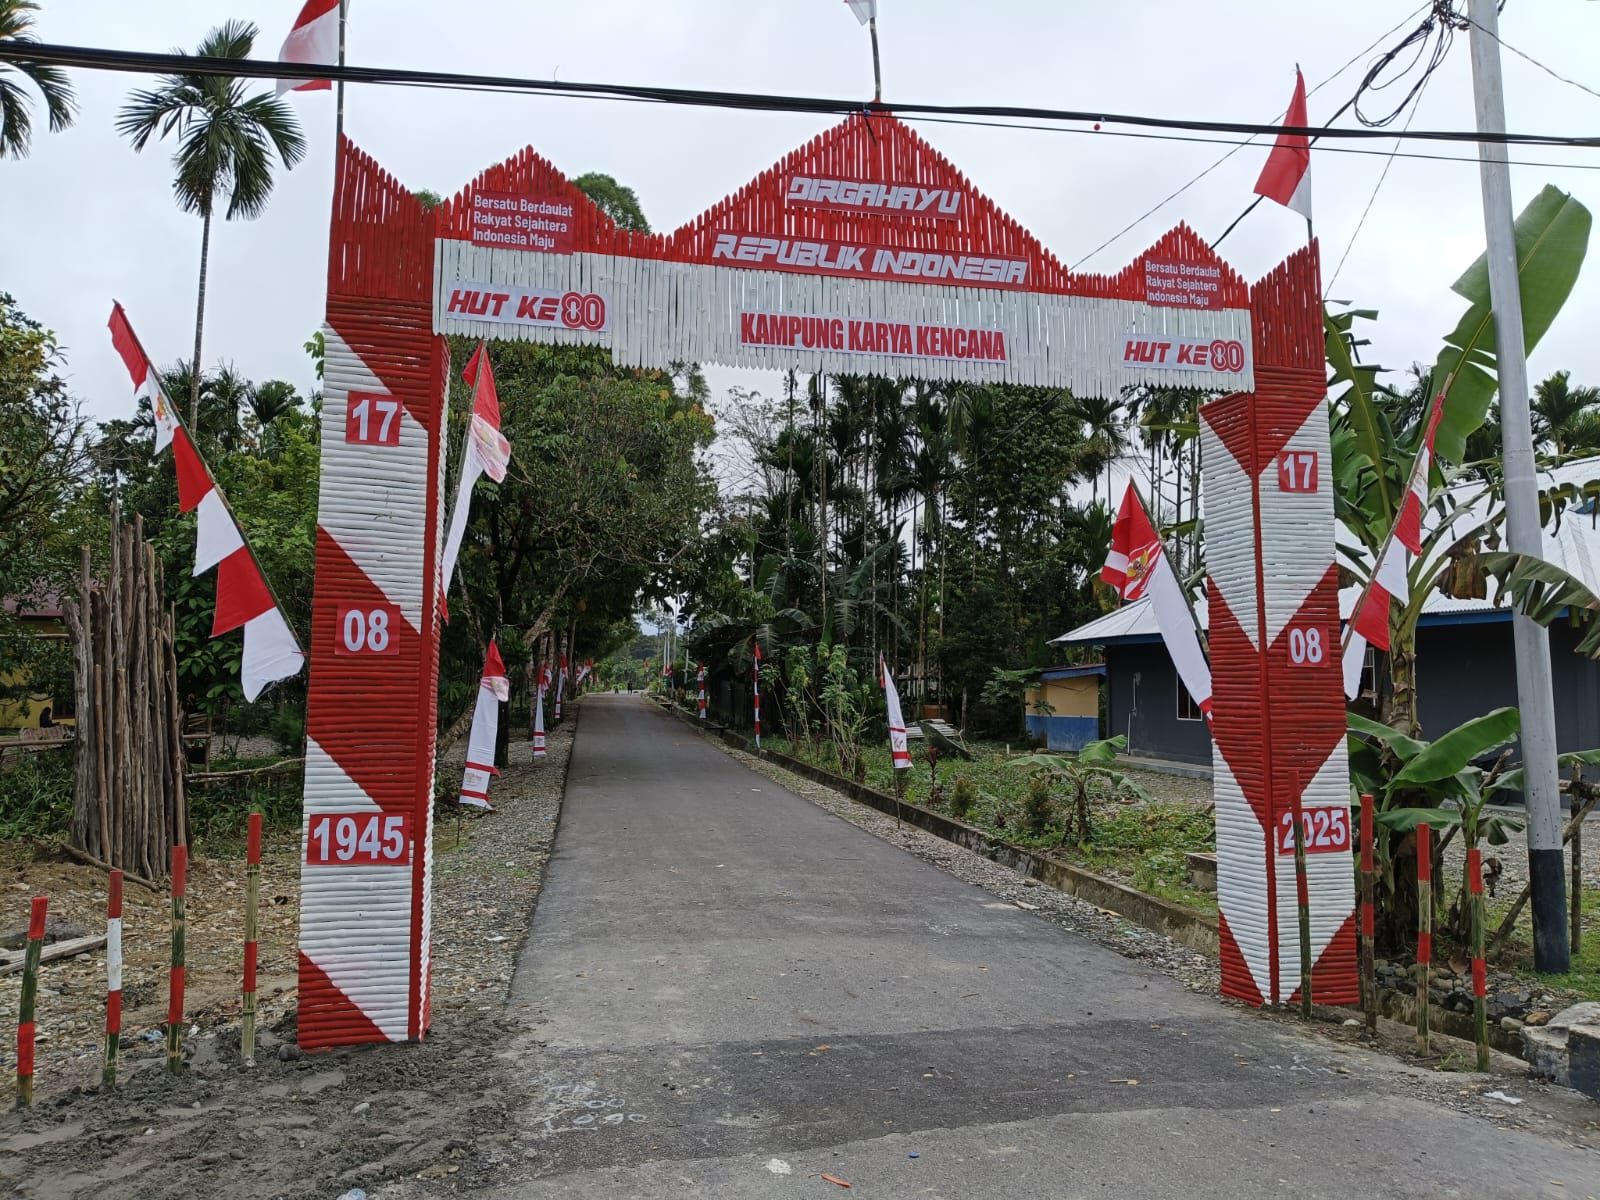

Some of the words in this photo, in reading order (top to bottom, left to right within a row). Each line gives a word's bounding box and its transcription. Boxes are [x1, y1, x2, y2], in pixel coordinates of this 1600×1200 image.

[474, 195, 518, 211] Bersatu
[520, 199, 573, 217] Berdaulat
[788, 176, 961, 214] DIRGAHAYU
[473, 212, 512, 228] Rakyat
[514, 217, 567, 234] Sejahtera
[473, 227, 527, 245] Indonesia
[529, 233, 555, 249] Maju
[712, 233, 866, 271] REPUBLIK
[871, 249, 1028, 284] INDONESIA
[1145, 260, 1178, 273] Bersatu
[1180, 264, 1221, 278] Berdaulat
[1146, 275, 1175, 290] Rakyat
[1177, 278, 1217, 293] Sejahtera
[1146, 290, 1188, 304] Indonesia
[1189, 293, 1209, 307] Maju
[447, 289, 509, 316] HUT
[741, 312, 844, 350] KAMPUNG
[848, 320, 913, 355] KARYA
[916, 326, 1006, 360] KENCANA
[1124, 340, 1171, 363] HUT
[352, 399, 398, 442] 17
[1283, 453, 1314, 489] 17
[343, 609, 389, 651] 08
[1289, 627, 1322, 664] 08
[313, 815, 404, 861] 1945
